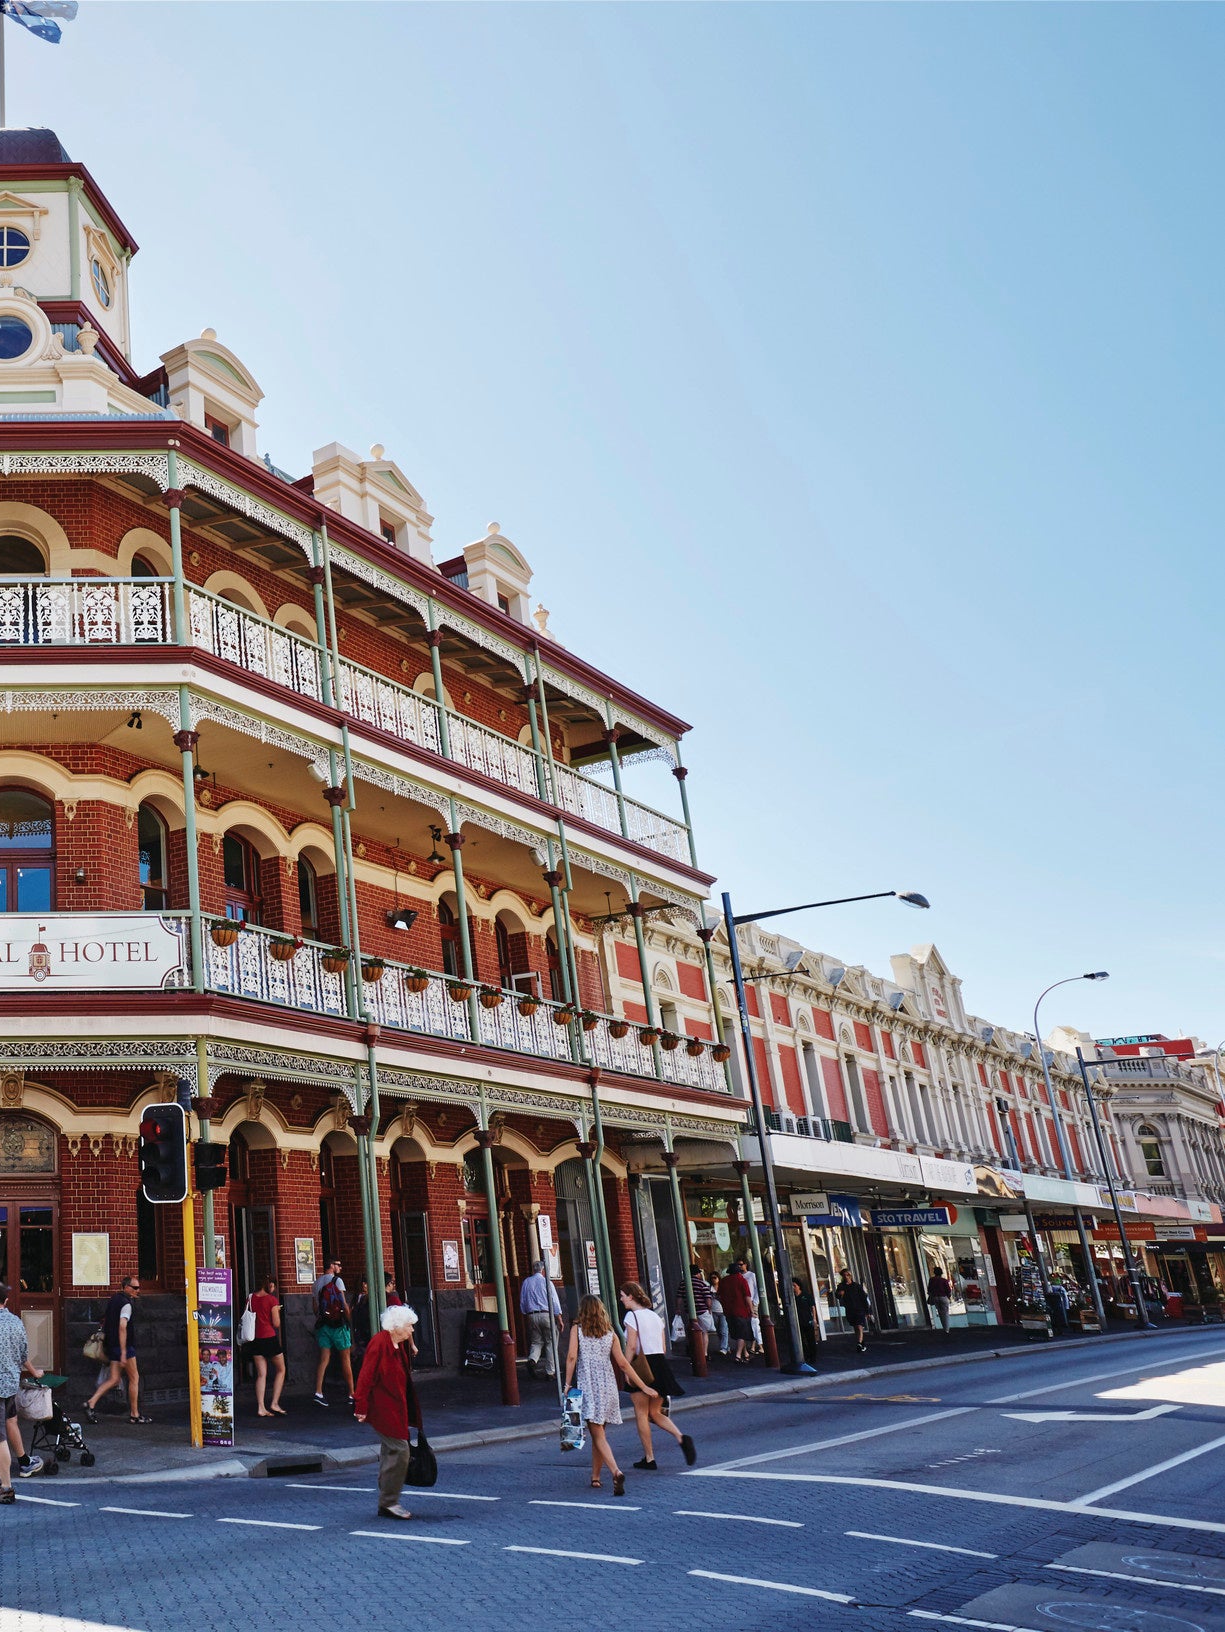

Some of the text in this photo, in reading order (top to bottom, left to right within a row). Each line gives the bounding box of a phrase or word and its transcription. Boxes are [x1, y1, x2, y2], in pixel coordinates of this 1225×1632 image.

[59, 941, 159, 962] HOTEL
[795, 1199, 825, 1210] Morrison
[877, 1213, 943, 1223] sta TRAVEL
